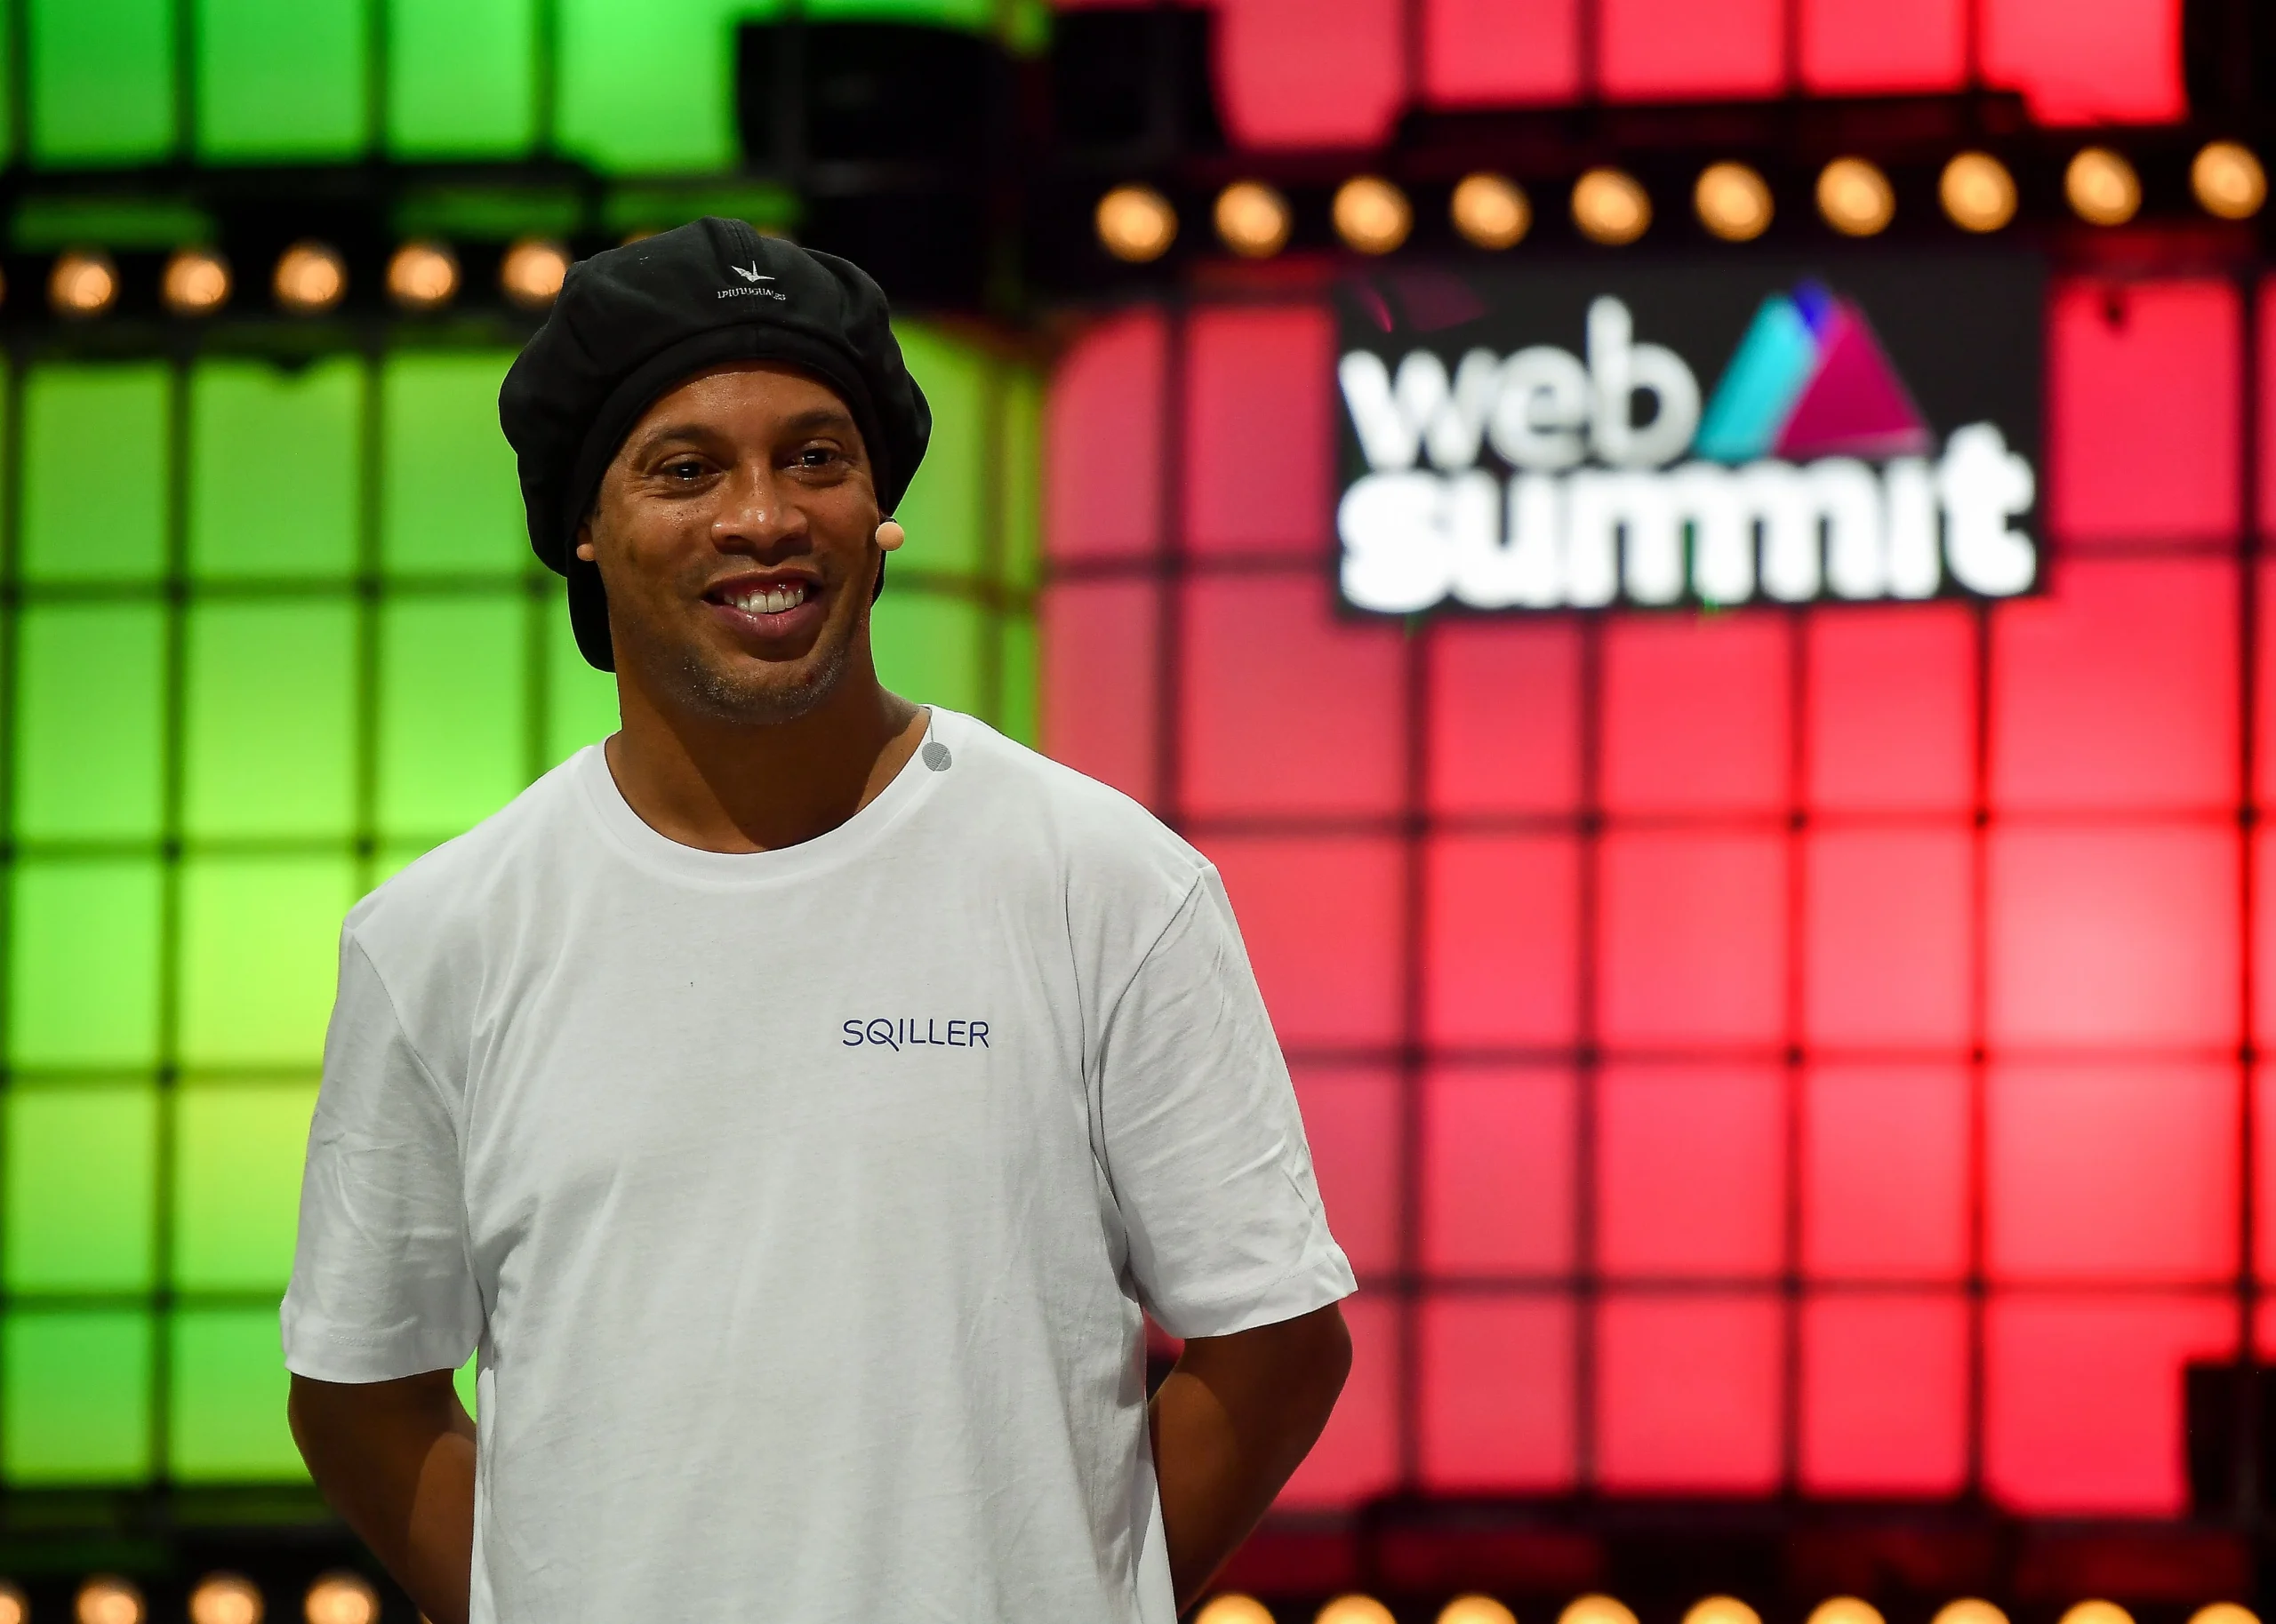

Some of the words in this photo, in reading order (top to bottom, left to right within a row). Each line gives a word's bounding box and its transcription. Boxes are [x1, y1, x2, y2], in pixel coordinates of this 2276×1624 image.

[1338, 296, 1701, 469] web
[1337, 421, 2036, 613] summit
[842, 1018, 990, 1052] SQILLER
